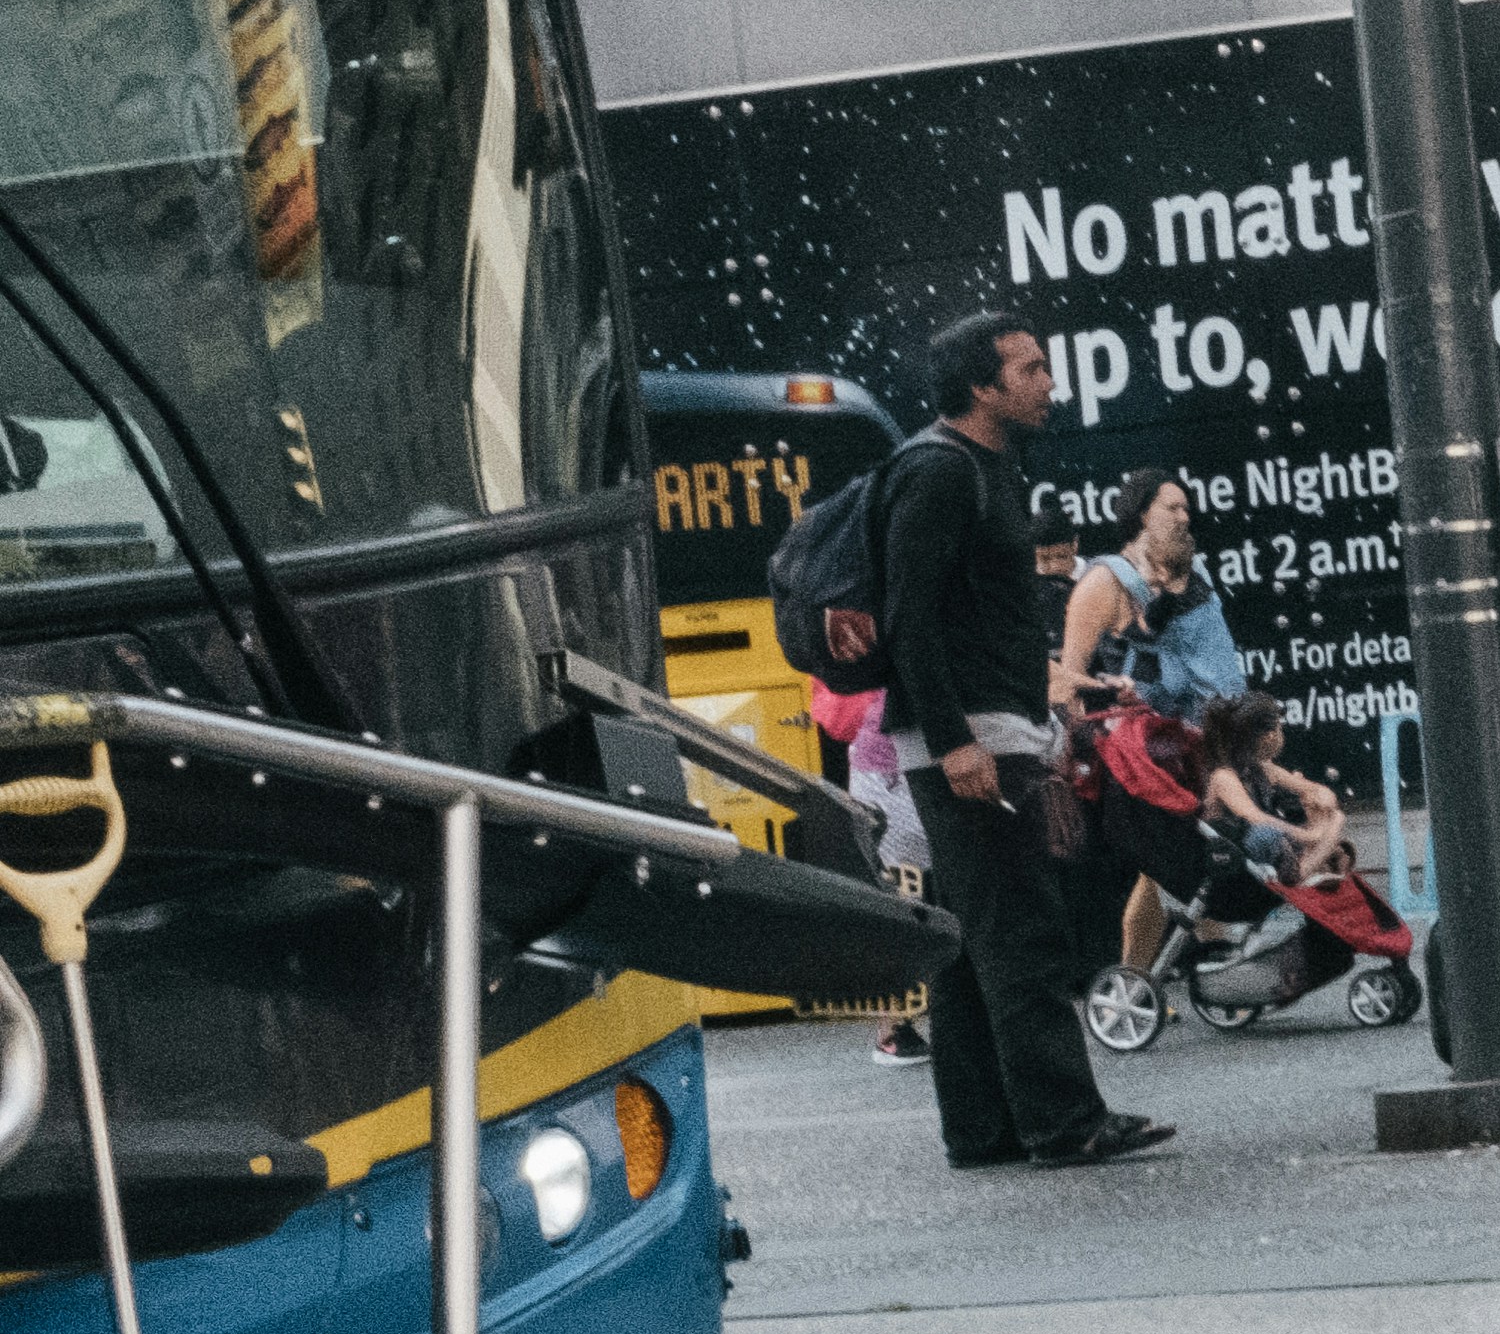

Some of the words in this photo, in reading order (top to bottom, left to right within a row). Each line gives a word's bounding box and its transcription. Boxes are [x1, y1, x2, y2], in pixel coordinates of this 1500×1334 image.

[1004, 187, 1127, 283] No
[1152, 156, 1375, 266] matt
[1151, 303, 1271, 400] to,
[1246, 448, 1403, 515] NightB
[1218, 538, 1263, 585] at
[1270, 534, 1300, 579] 2
[1290, 637, 1338, 671] For
[1343, 630, 1412, 667] deta
